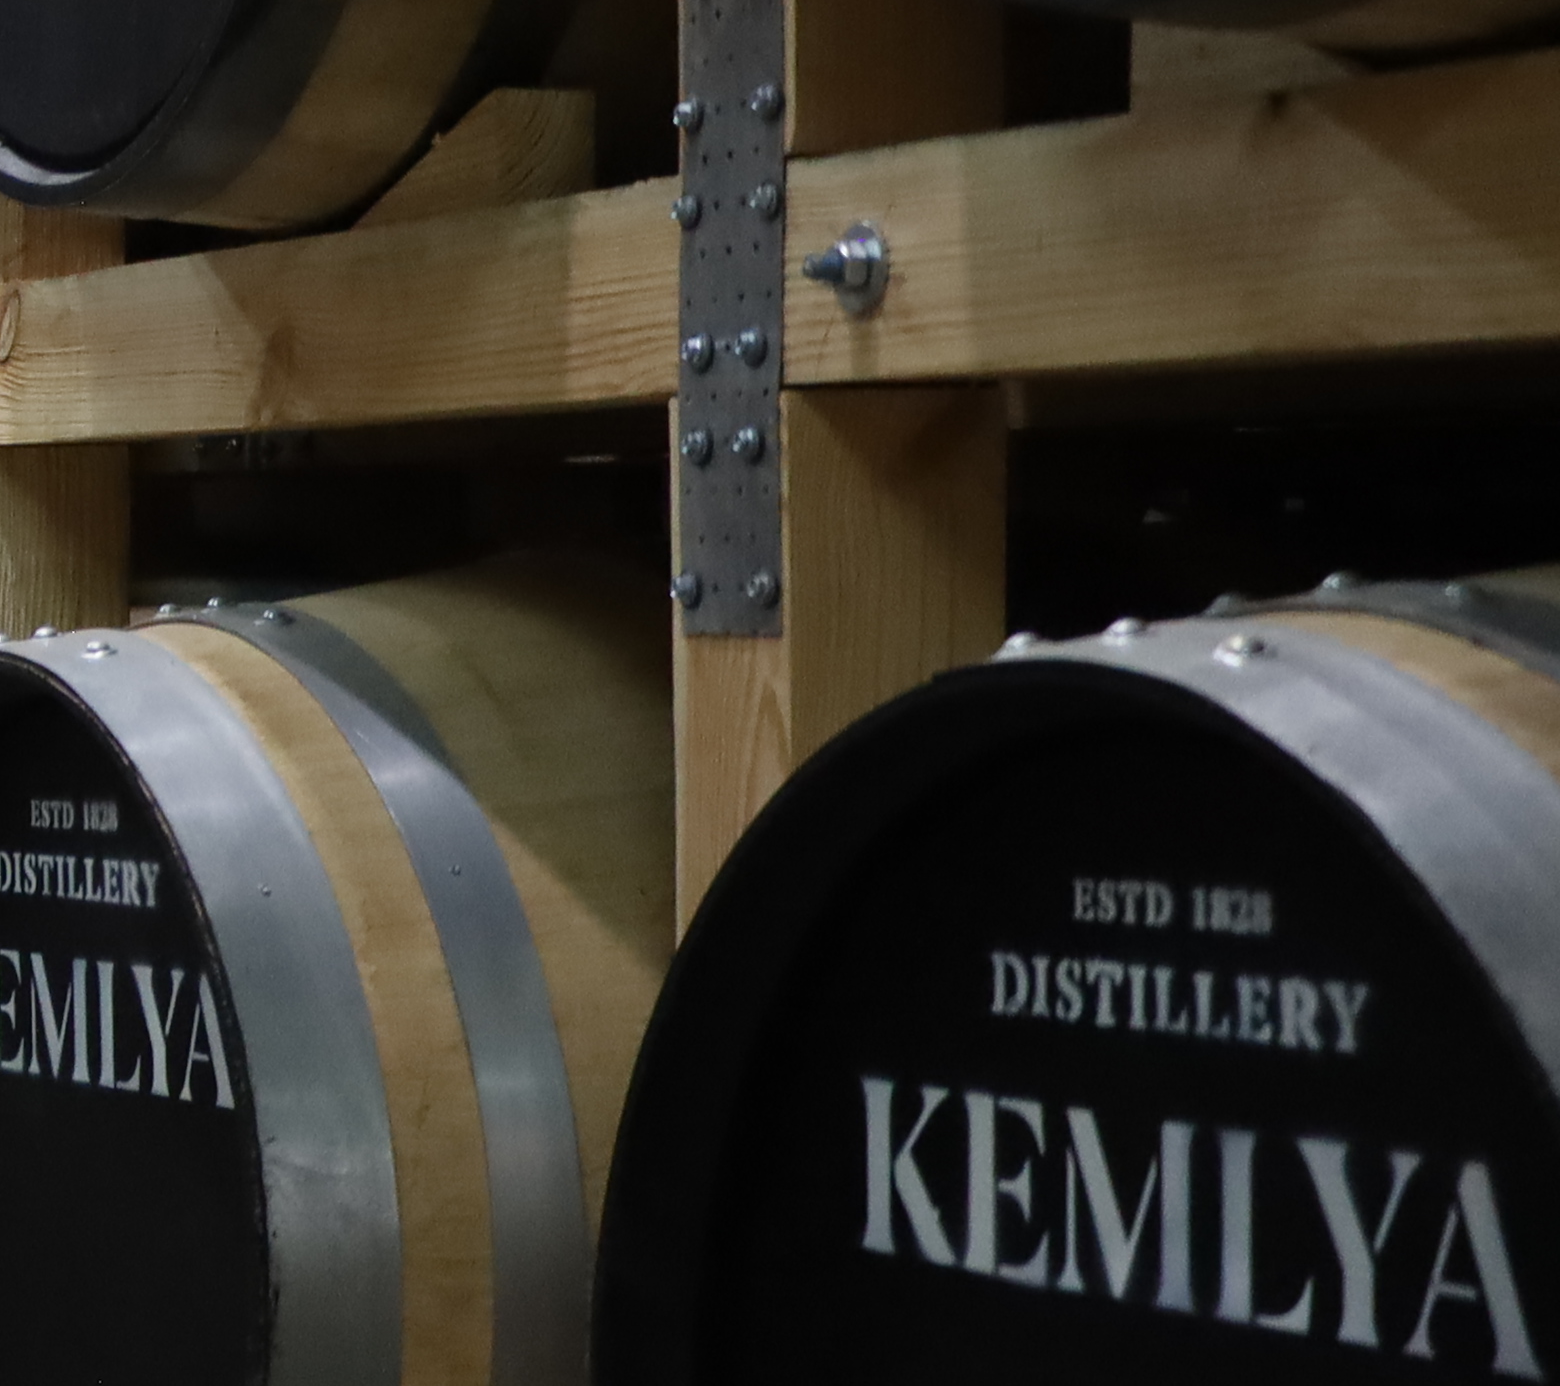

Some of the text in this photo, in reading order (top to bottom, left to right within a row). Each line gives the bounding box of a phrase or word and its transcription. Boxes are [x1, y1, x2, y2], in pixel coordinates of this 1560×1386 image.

[30, 799, 75, 830] ESTD
[1072, 878, 1173, 927] ESTD
[991, 950, 1370, 1054] DISTILLERY
[861, 1075, 1544, 1382] KEMLYA
